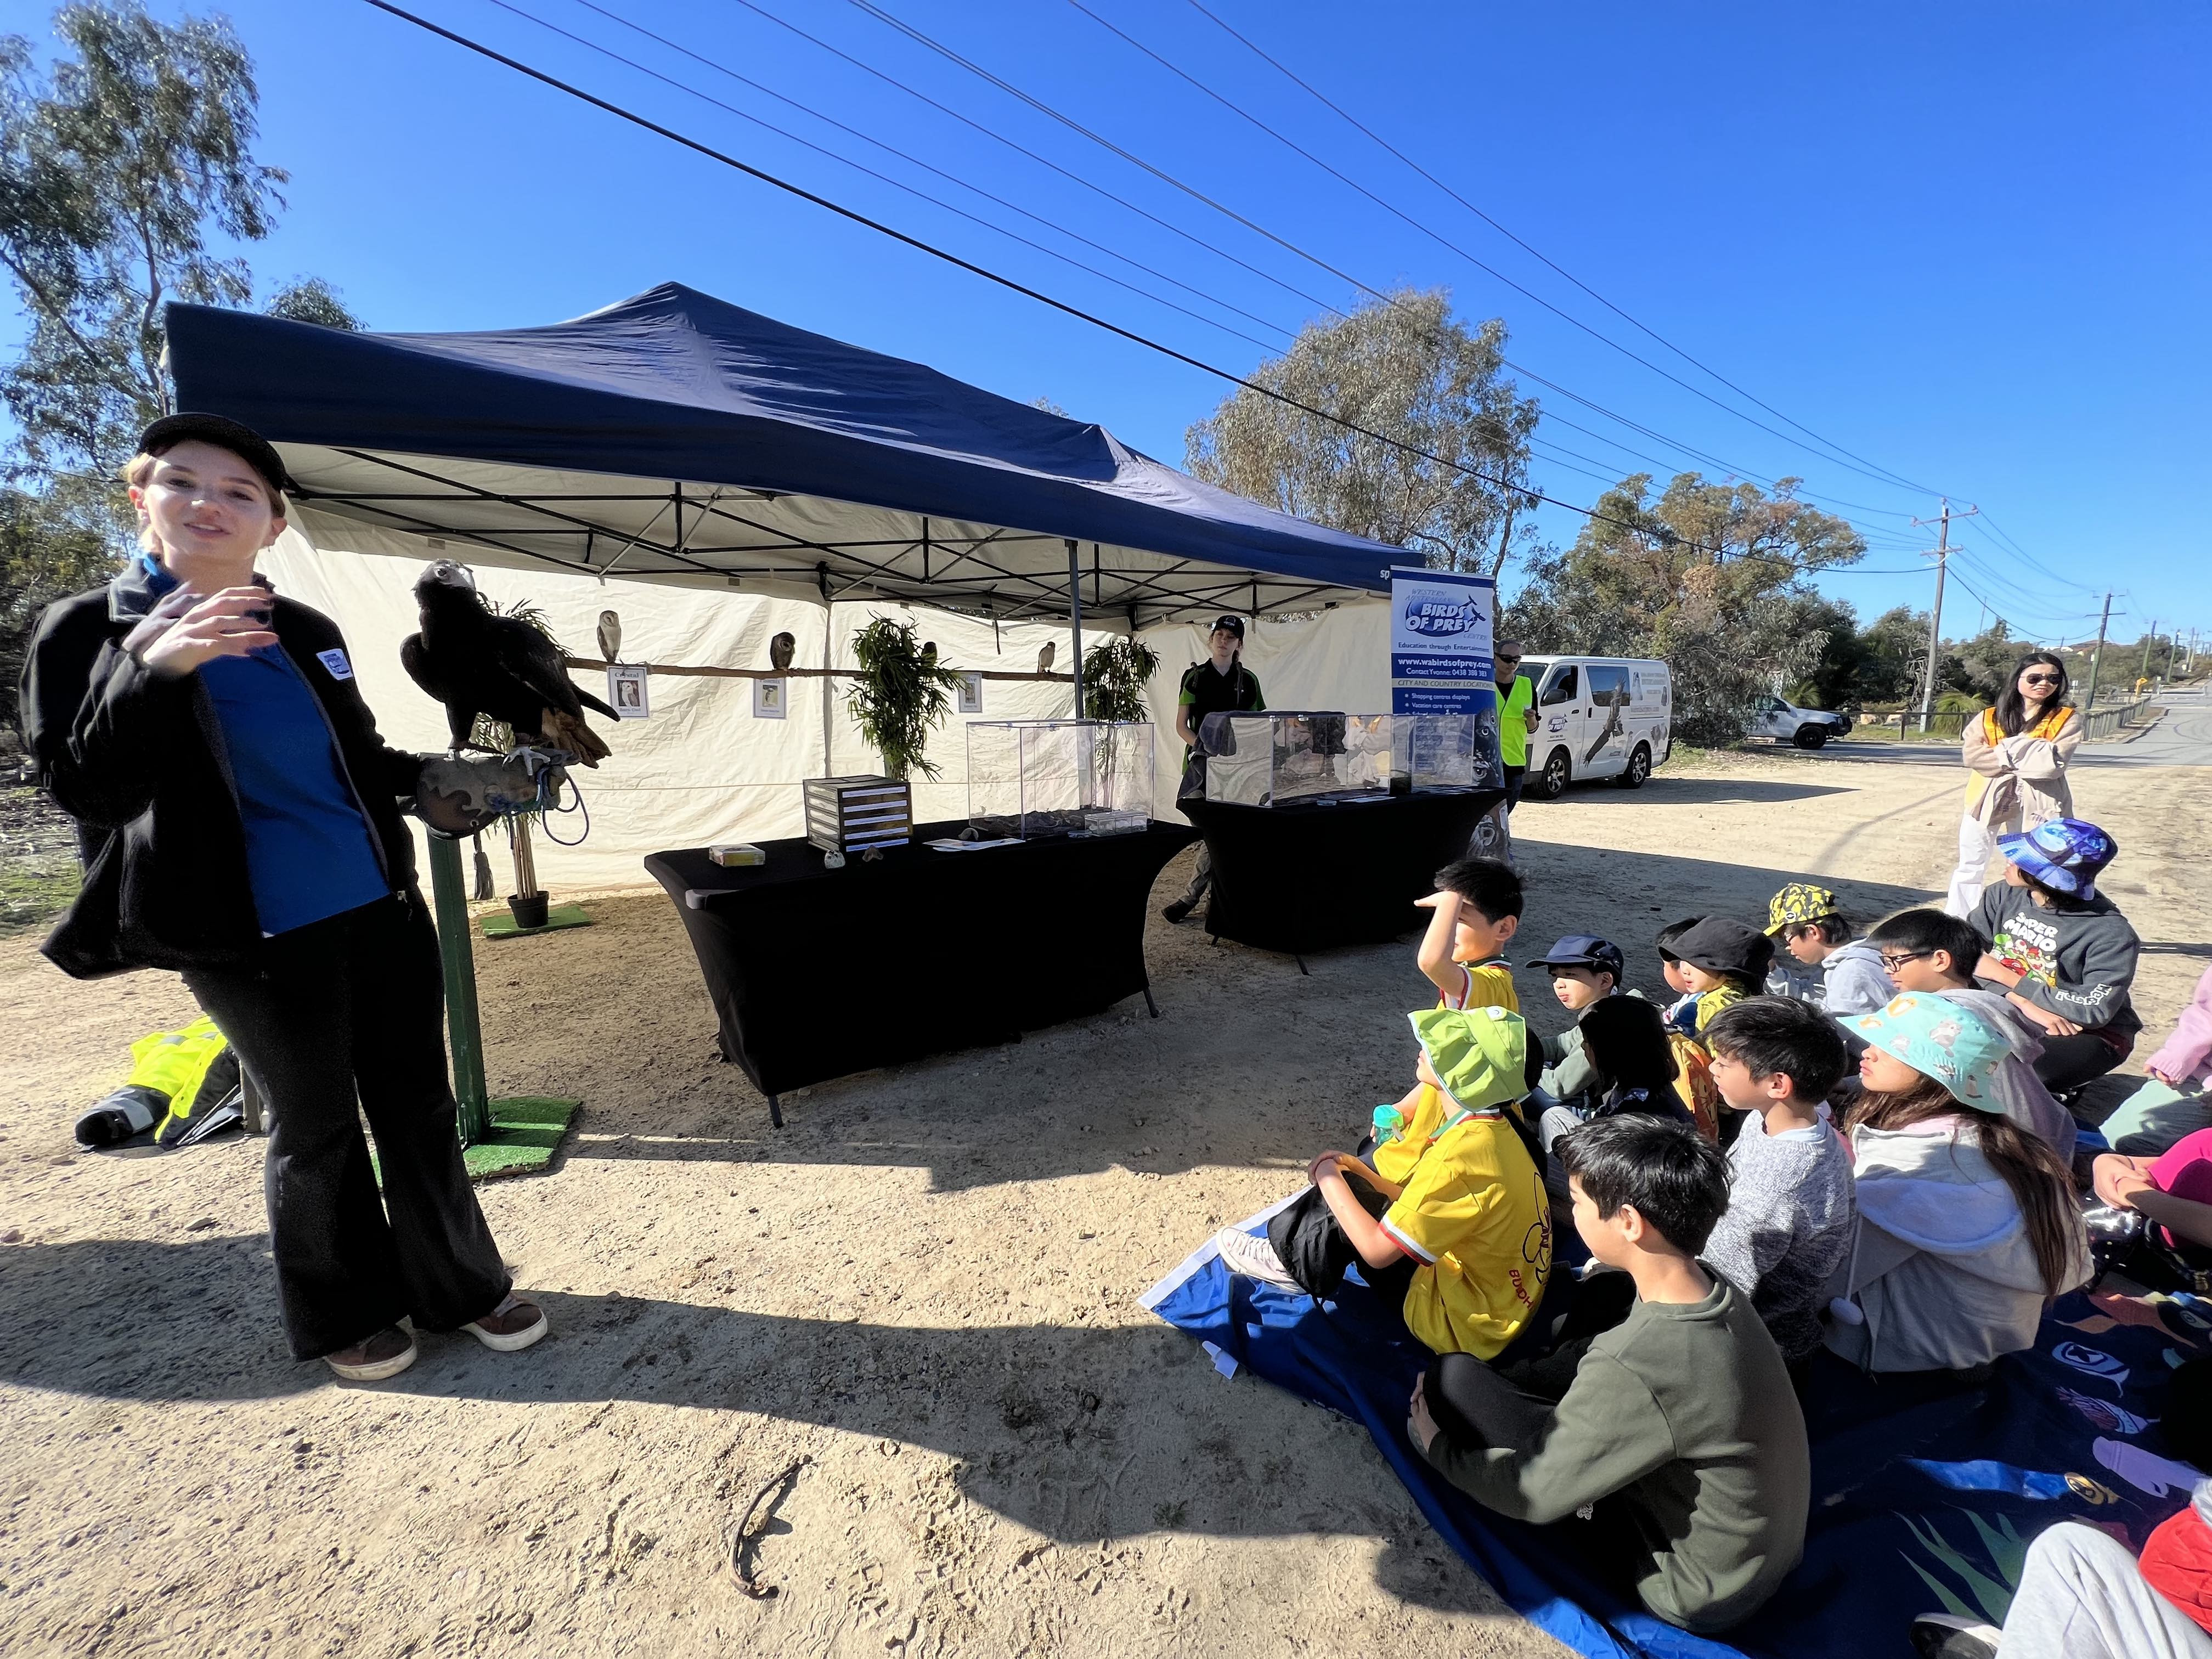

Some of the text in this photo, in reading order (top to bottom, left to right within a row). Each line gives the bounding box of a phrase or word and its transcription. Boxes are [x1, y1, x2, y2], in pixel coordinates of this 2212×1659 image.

[1421, 603, 1467, 619] BIRDS
[1406, 616, 1474, 632] OF PREY
[1429, 643, 1452, 651] through
[1397, 658, 1492, 669] www.wabirdsofprey.com
[2015, 911, 2058, 938] SPER
[2002, 918, 2057, 952] MARIO
[1509, 1269, 1534, 1309] BUDH
